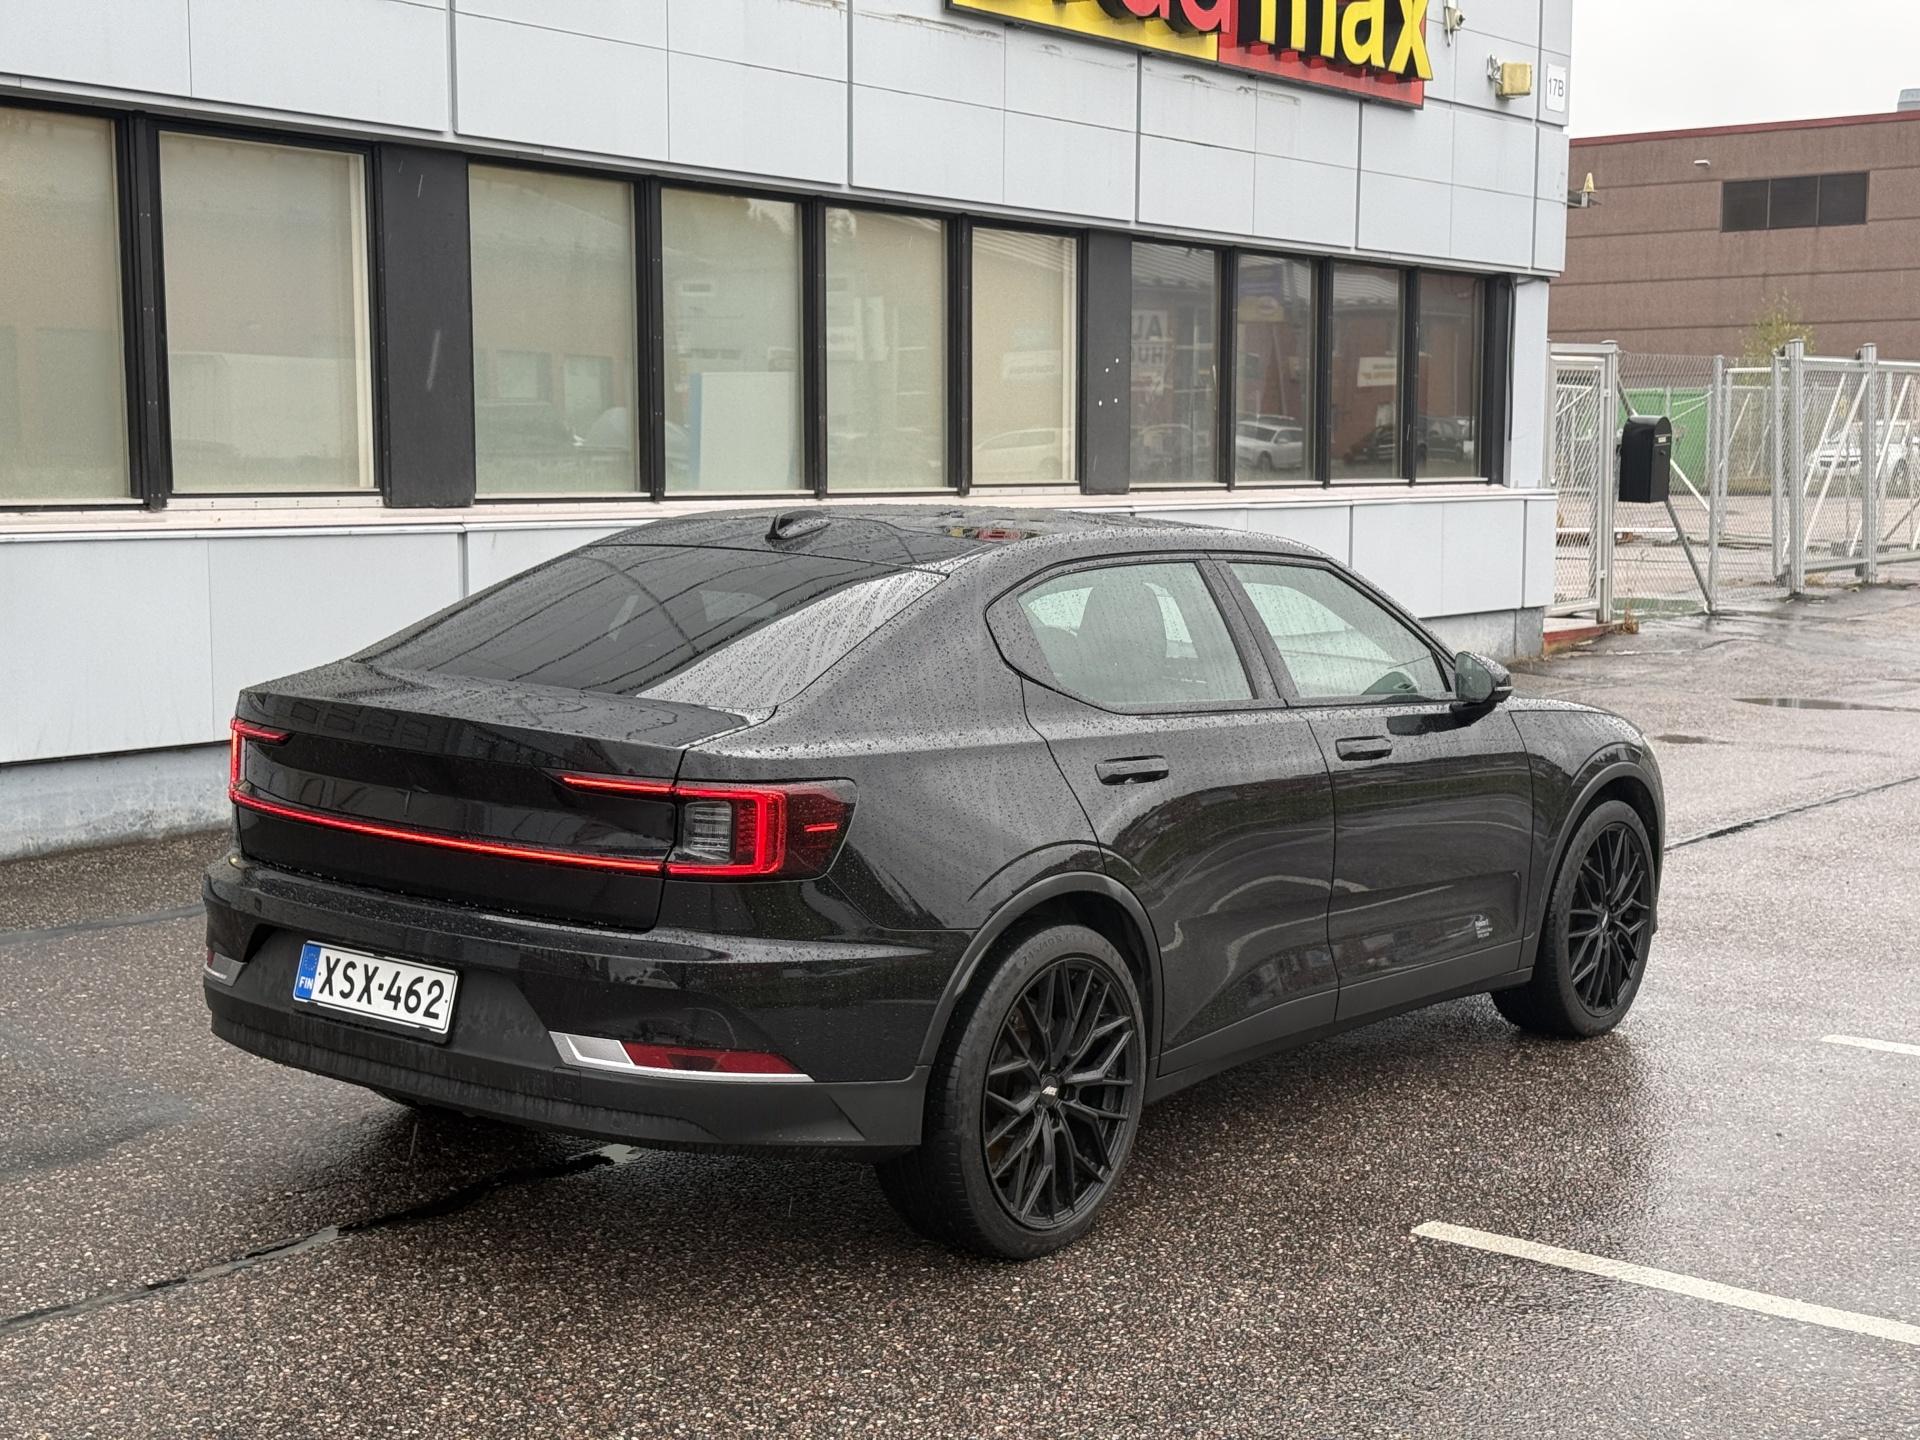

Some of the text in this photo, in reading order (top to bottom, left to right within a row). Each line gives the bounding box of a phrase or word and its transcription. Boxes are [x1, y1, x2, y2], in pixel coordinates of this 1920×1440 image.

[1548, 77, 1565, 97] 17B
[298, 975, 315, 990] FIN
[318, 955, 445, 1020] XSX-462
